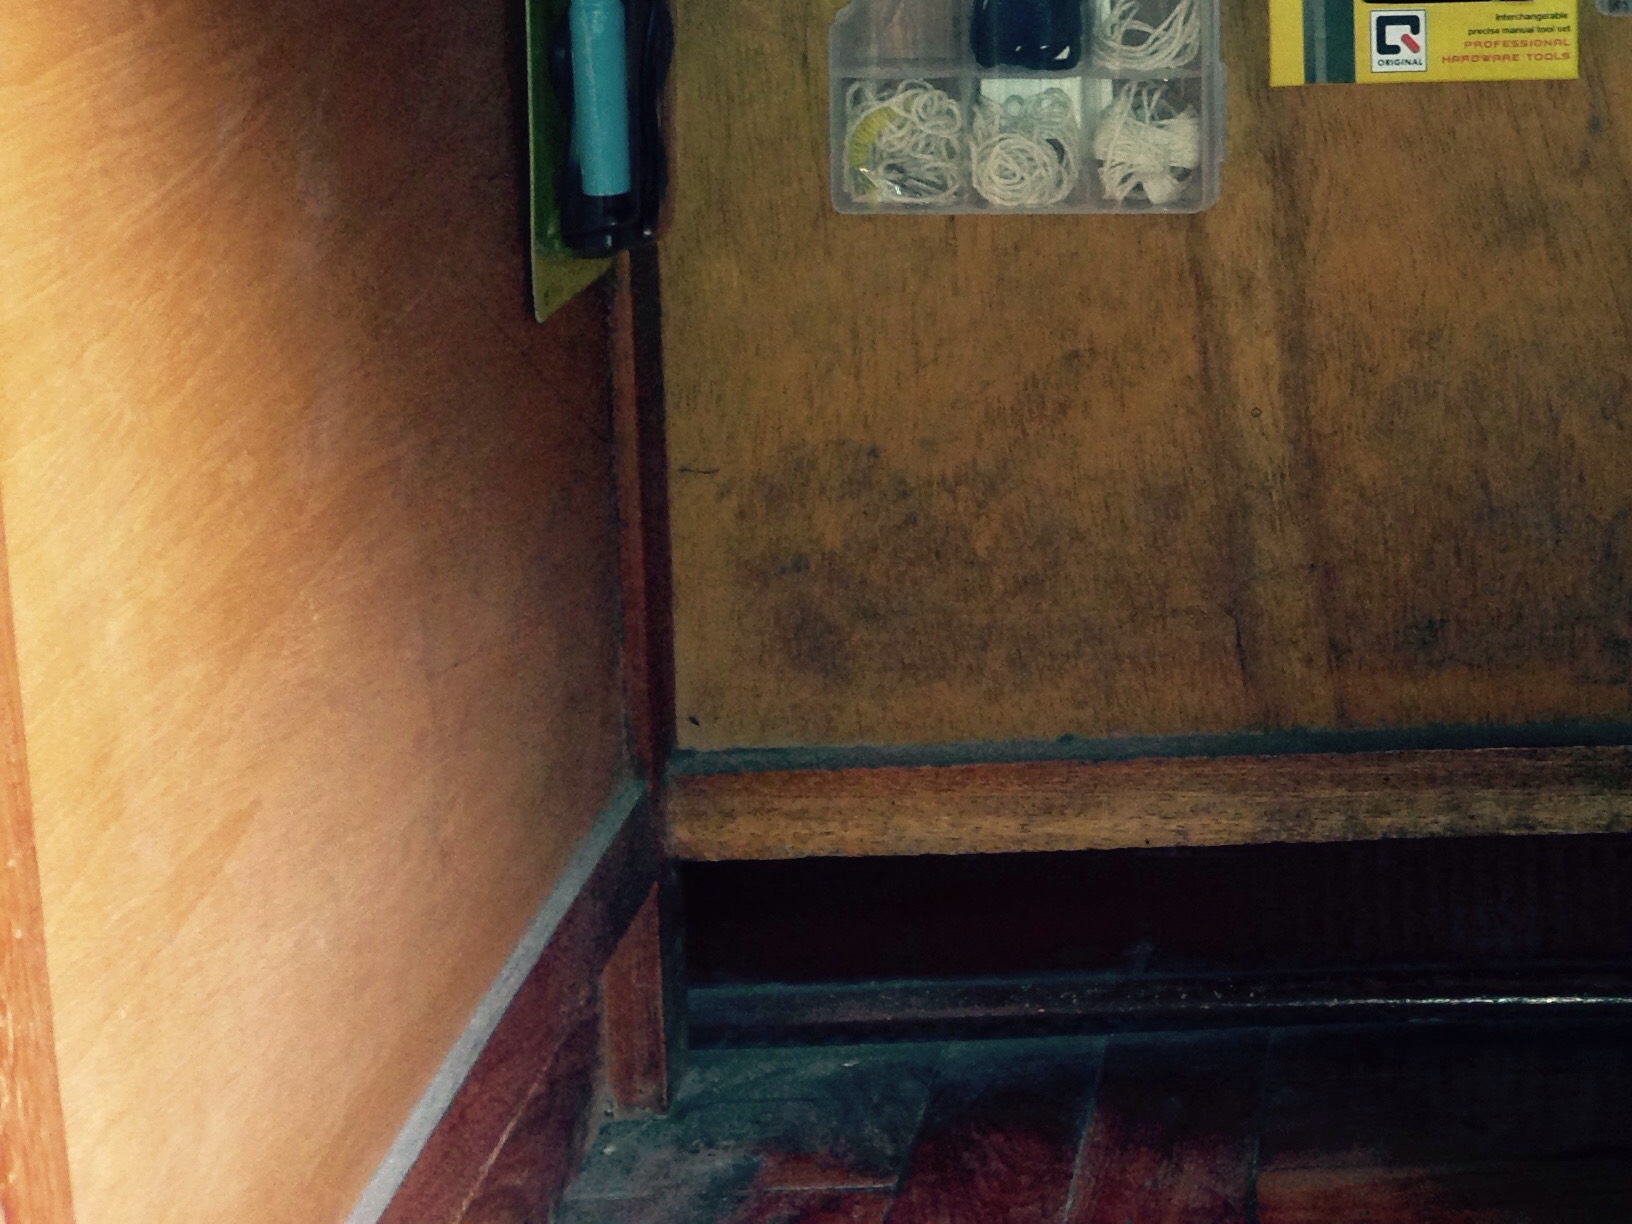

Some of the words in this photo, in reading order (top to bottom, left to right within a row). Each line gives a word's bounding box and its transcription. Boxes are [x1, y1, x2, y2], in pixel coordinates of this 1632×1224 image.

[1467, 27, 1500, 36] precise
[1502, 26, 1535, 35] manual
[1537, 25, 1555, 34] tool
[1557, 24, 1571, 33] set
[1464, 38, 1571, 49] PROFESSIONAL
[1377, 59, 1423, 67] ORIGINAL
[1441, 53, 1520, 64] HARDWARE
[1526, 51, 1571, 62] TOOLS
